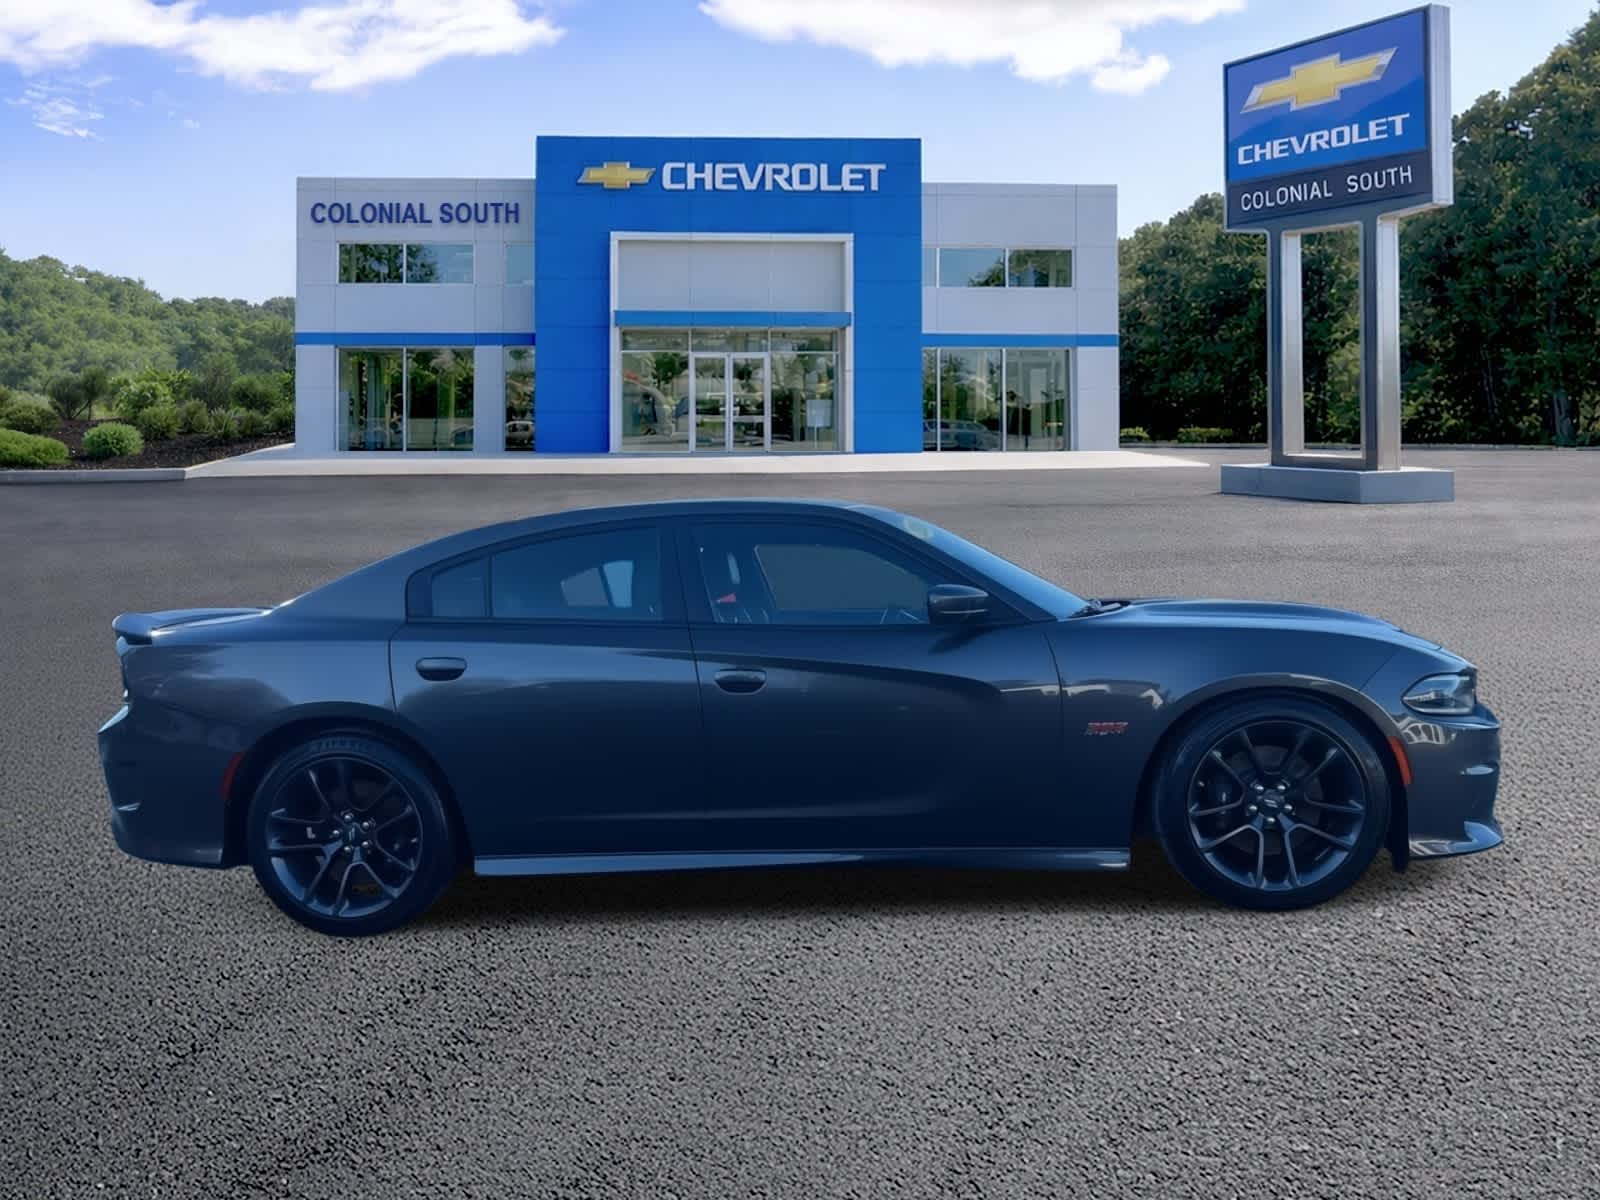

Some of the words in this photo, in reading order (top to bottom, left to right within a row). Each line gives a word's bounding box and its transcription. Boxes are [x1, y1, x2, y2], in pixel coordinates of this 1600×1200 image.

[1237, 113, 1410, 165] CHEVROLET
[662, 162, 886, 192] CHEVROLET
[1240, 180, 1333, 211] COLONIAL
[1346, 165, 1413, 193] SOUTH
[310, 202, 432, 224] COLONIAL
[439, 202, 520, 224] SOUTH
